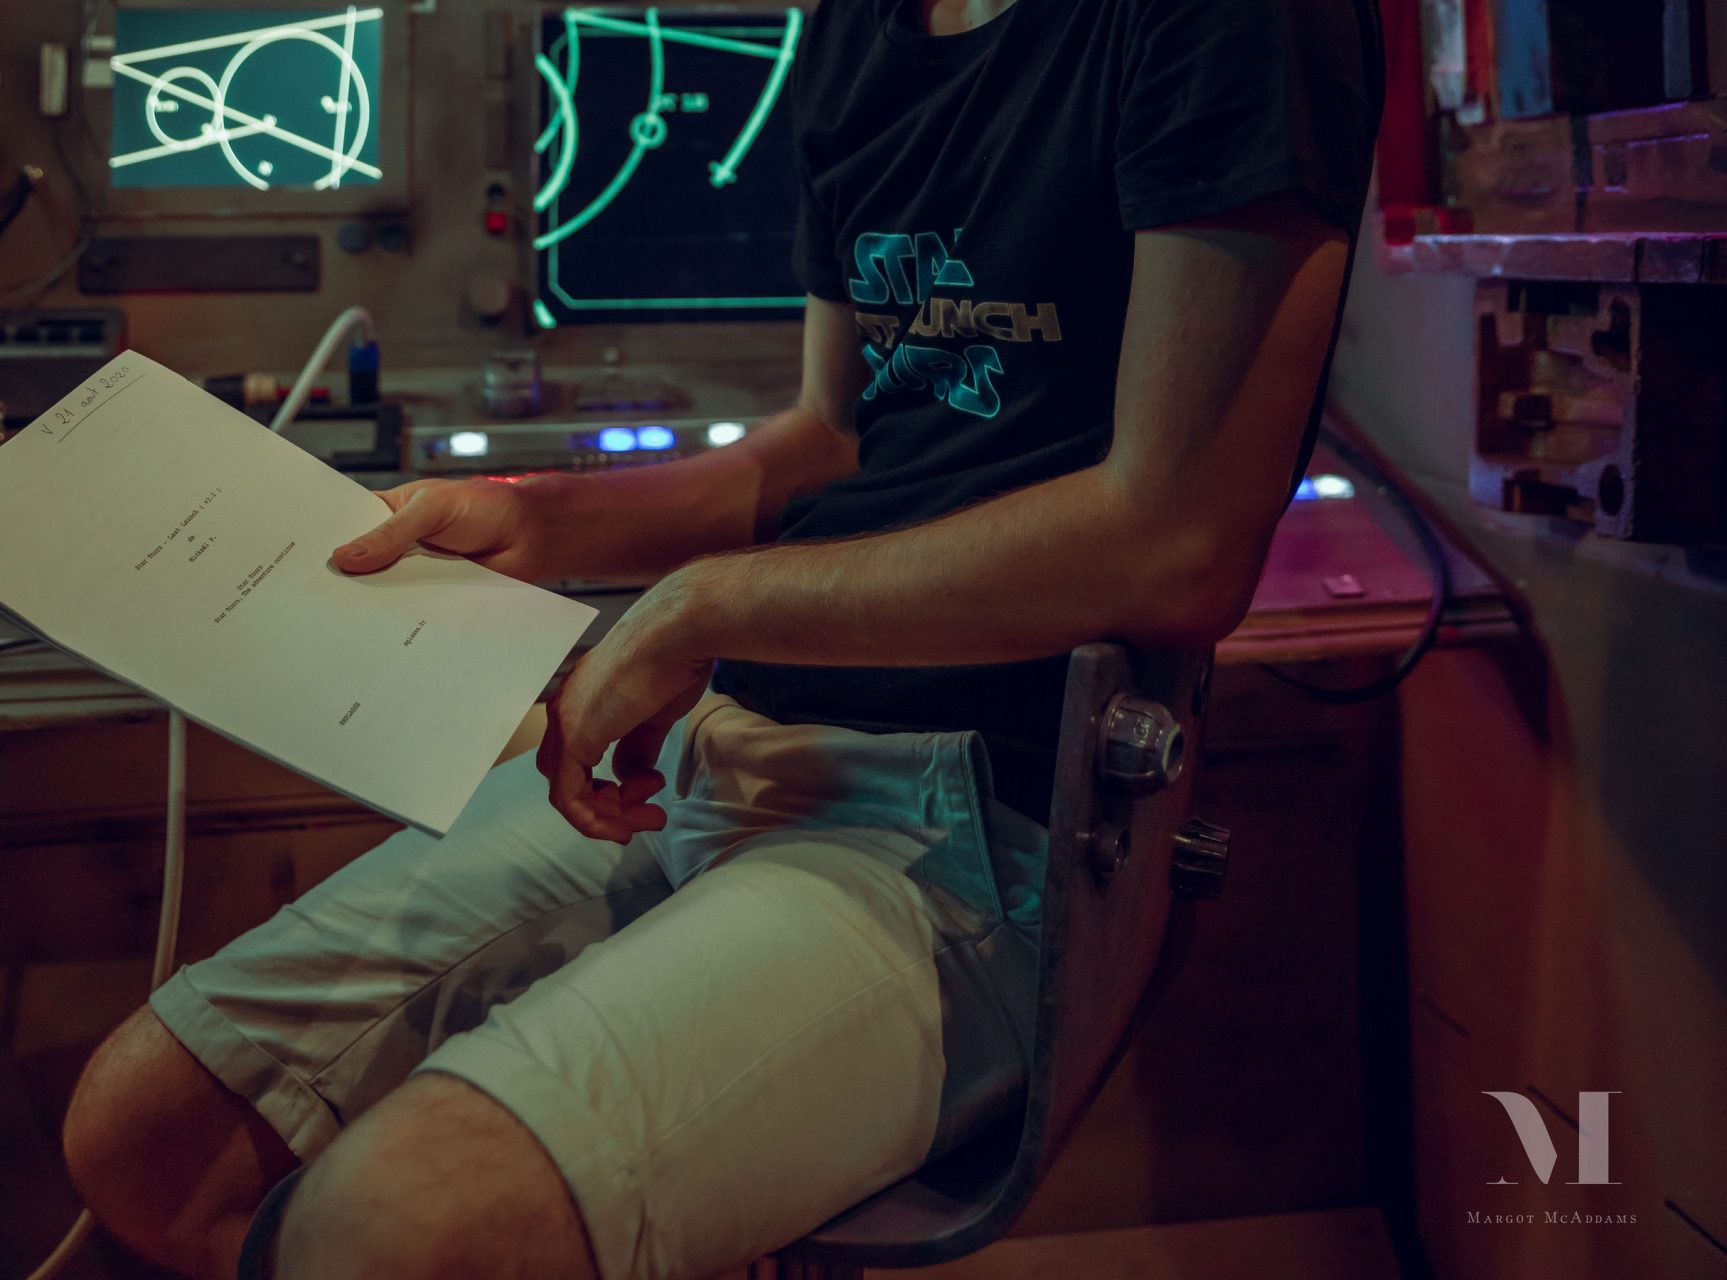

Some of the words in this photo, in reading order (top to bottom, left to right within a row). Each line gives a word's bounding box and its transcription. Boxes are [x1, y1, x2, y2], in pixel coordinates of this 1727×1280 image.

[849, 228, 974, 304] STA
[55, 407, 76, 425] 21
[99, 366, 130, 389] 2020
[135, 559, 149, 570] Star
[147, 545, 164, 559] Tours
[166, 527, 182, 541] Last
[180, 509, 200, 528] Launch
[187, 535, 196, 543] de
[236, 578, 250, 591] Star
[247, 564, 264, 579] Tours
[213, 612, 227, 624] Star
